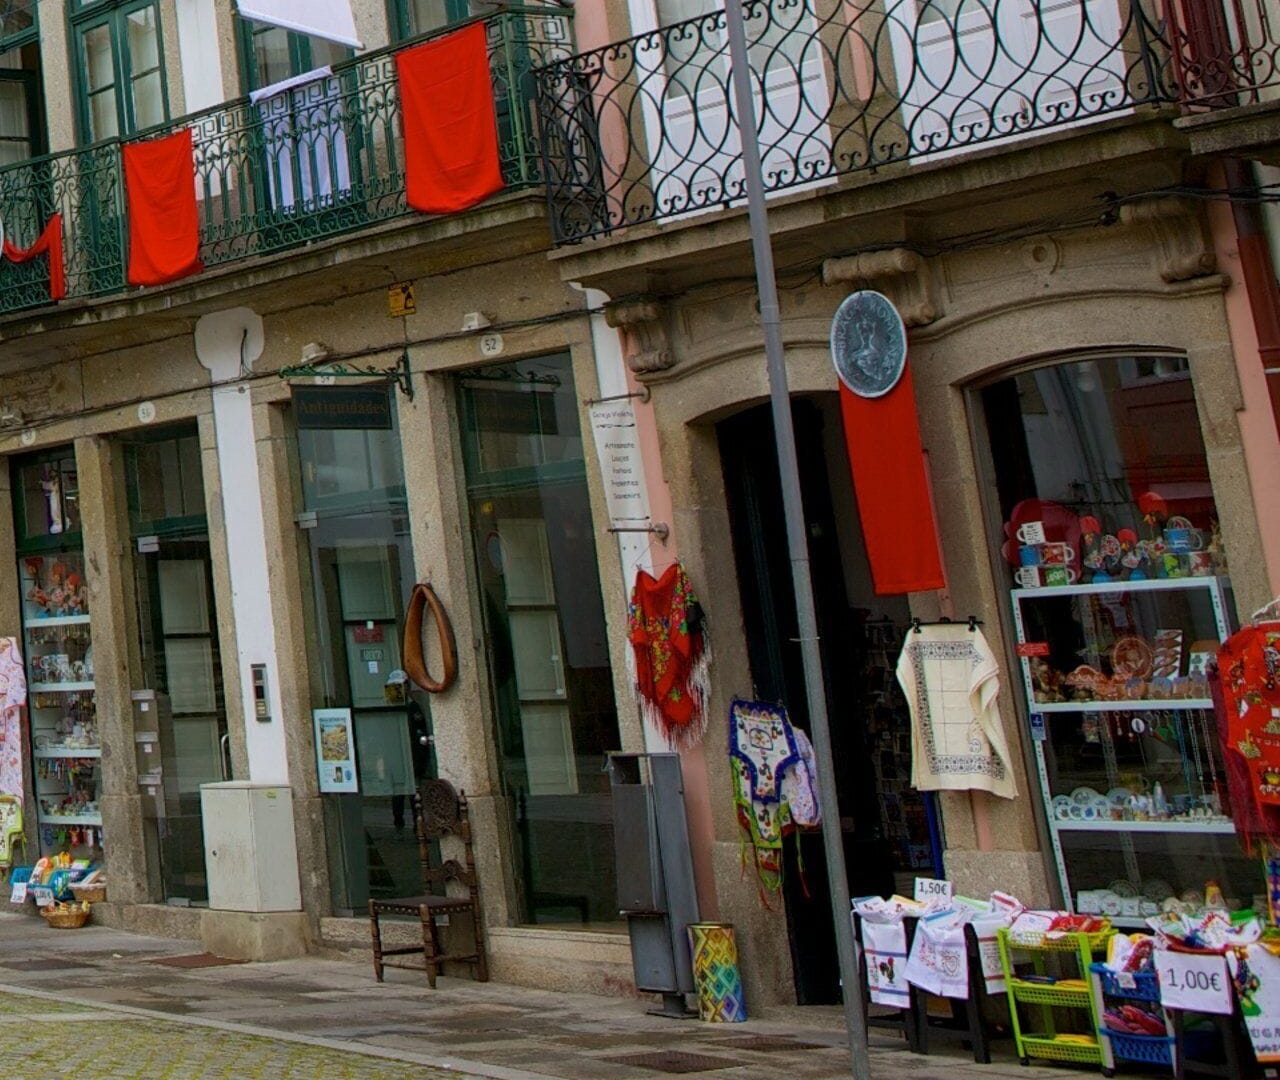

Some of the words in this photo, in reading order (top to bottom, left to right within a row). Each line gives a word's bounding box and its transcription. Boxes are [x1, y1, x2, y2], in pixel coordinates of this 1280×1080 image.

[299, 401, 386, 416] Antiguidades
[919, 881, 947, 896] 1,50€
[1166, 967, 1222, 993] 1,00€
